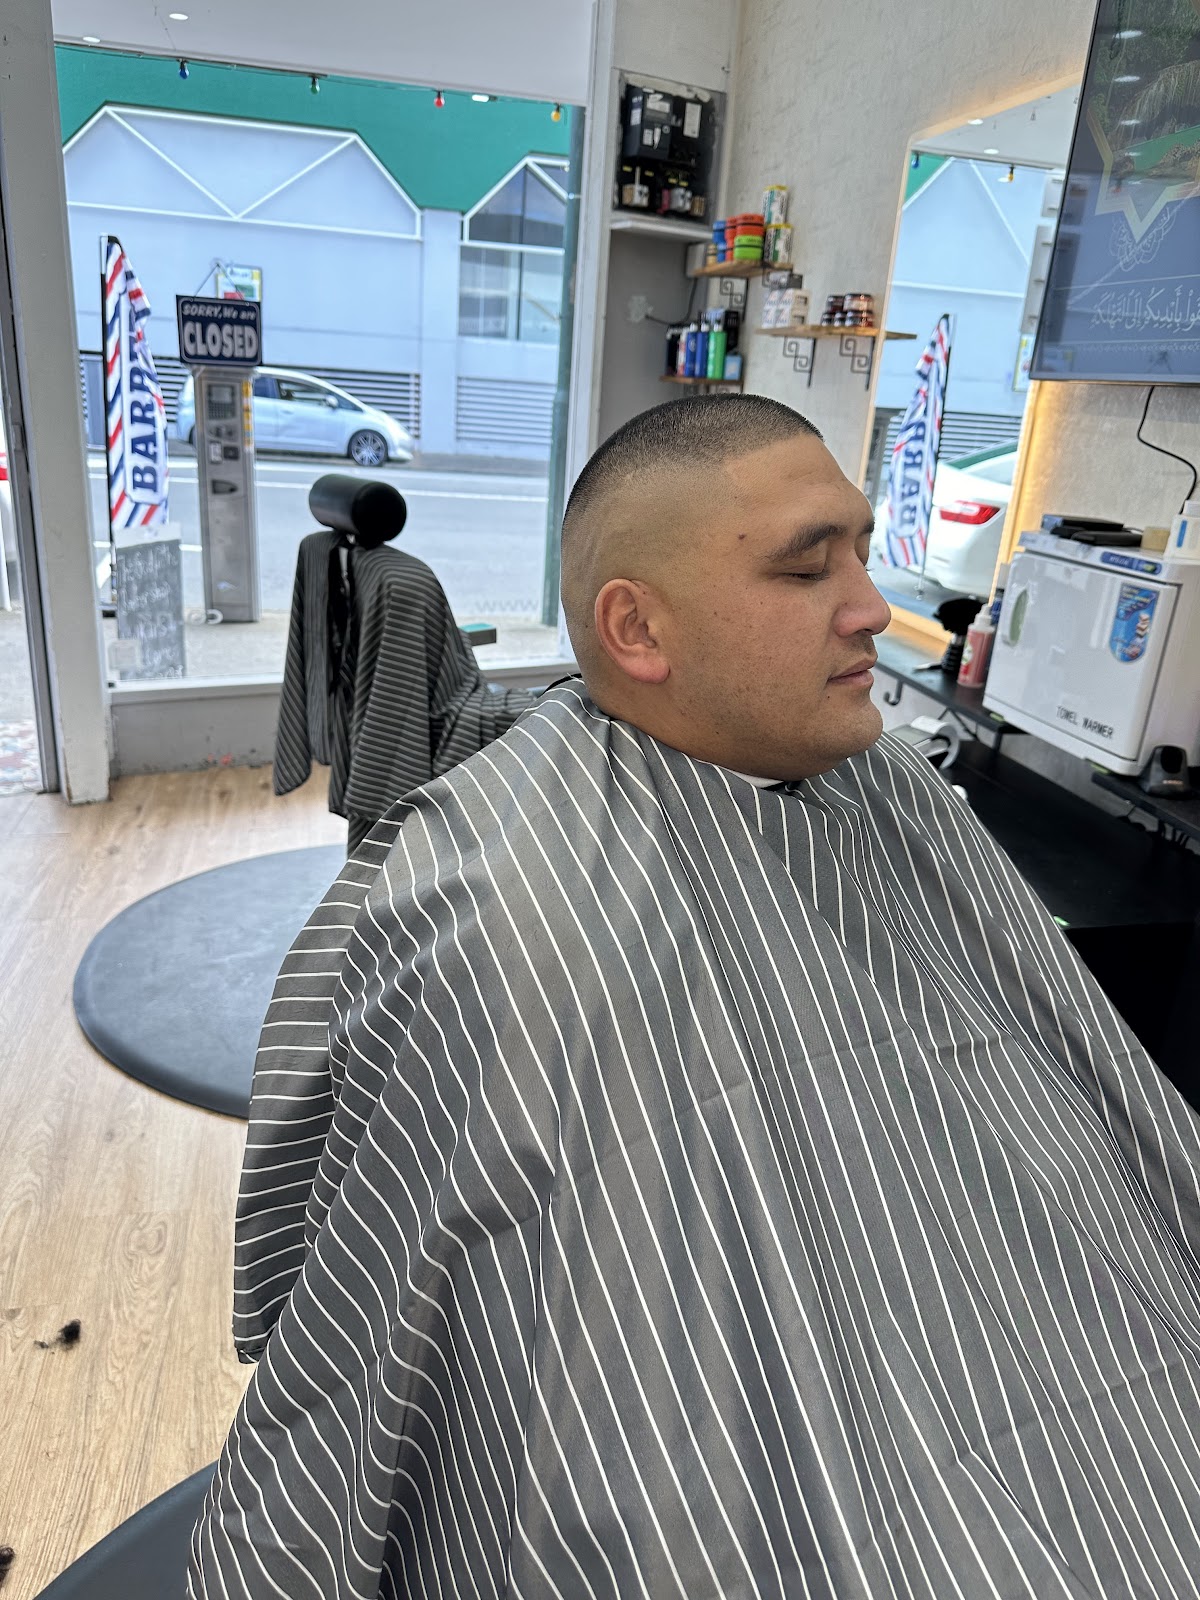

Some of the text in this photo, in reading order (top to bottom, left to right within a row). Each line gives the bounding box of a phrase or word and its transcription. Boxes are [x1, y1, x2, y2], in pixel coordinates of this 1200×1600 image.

[183, 321, 258, 358] CLOSED
[1056, 705, 1114, 739] TOWEL WARMER
